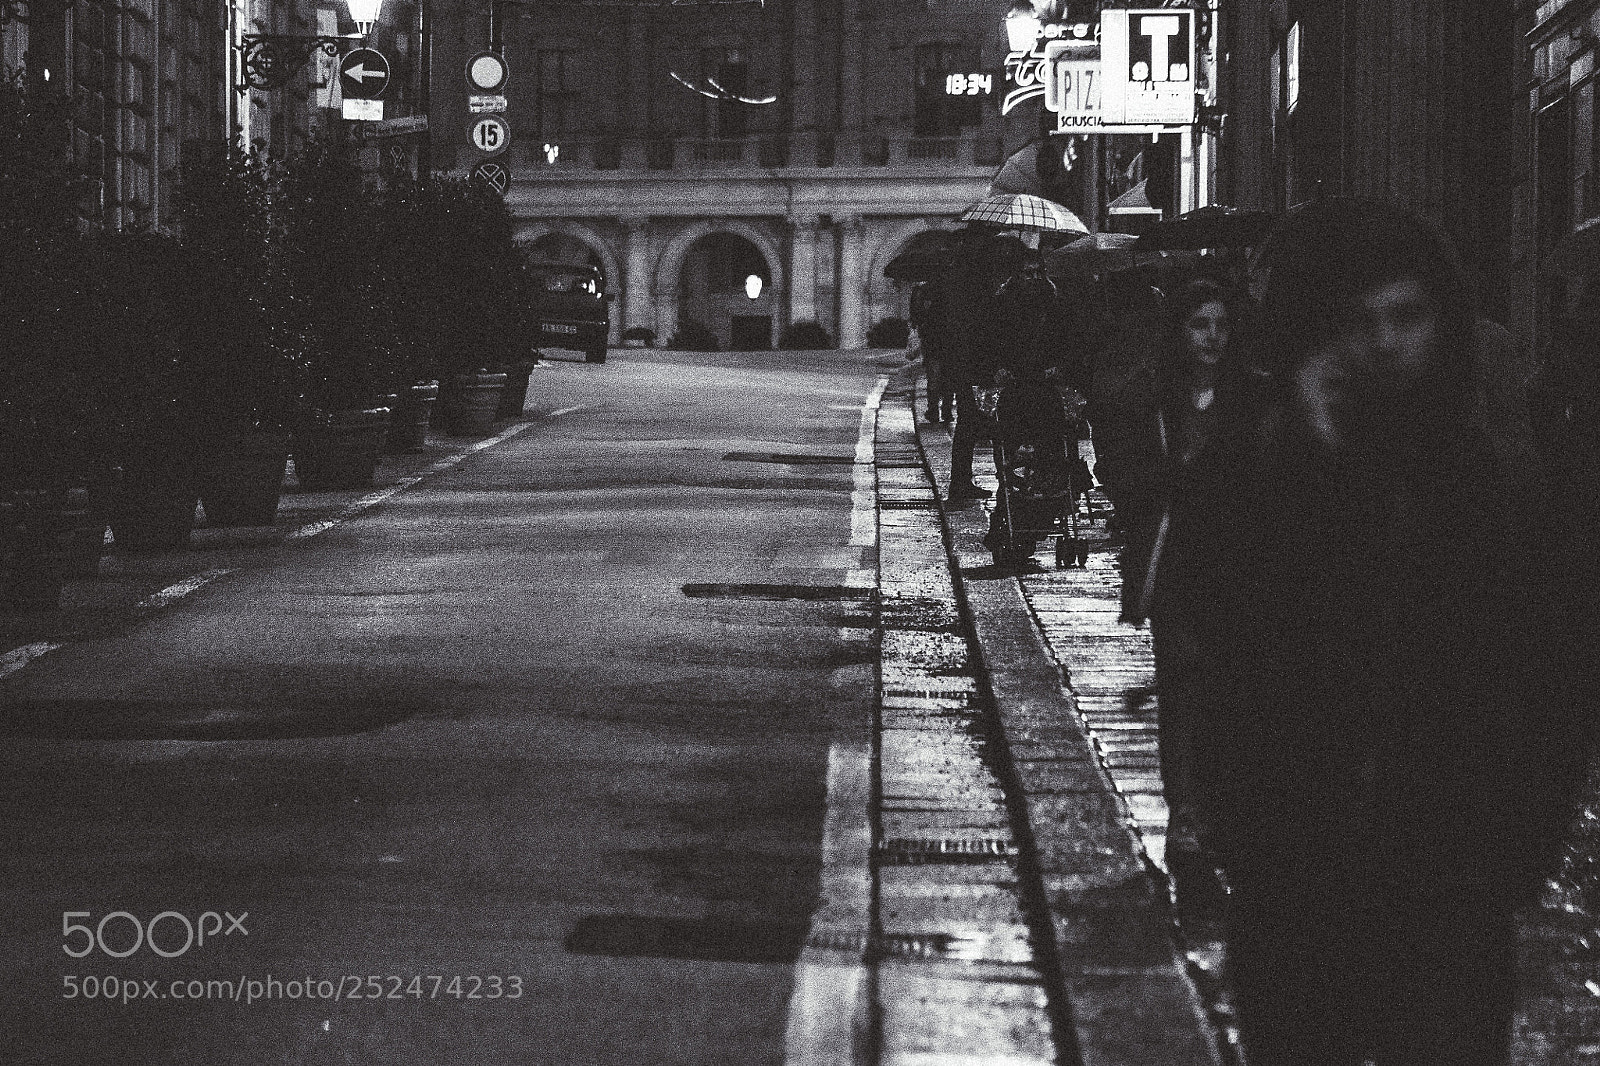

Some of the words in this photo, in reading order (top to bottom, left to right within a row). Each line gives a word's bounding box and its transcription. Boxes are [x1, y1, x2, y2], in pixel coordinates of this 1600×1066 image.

[946, 74, 992, 95] 18:34
[1064, 70, 1101, 110] PIZ
[481, 124, 498, 147] 15
